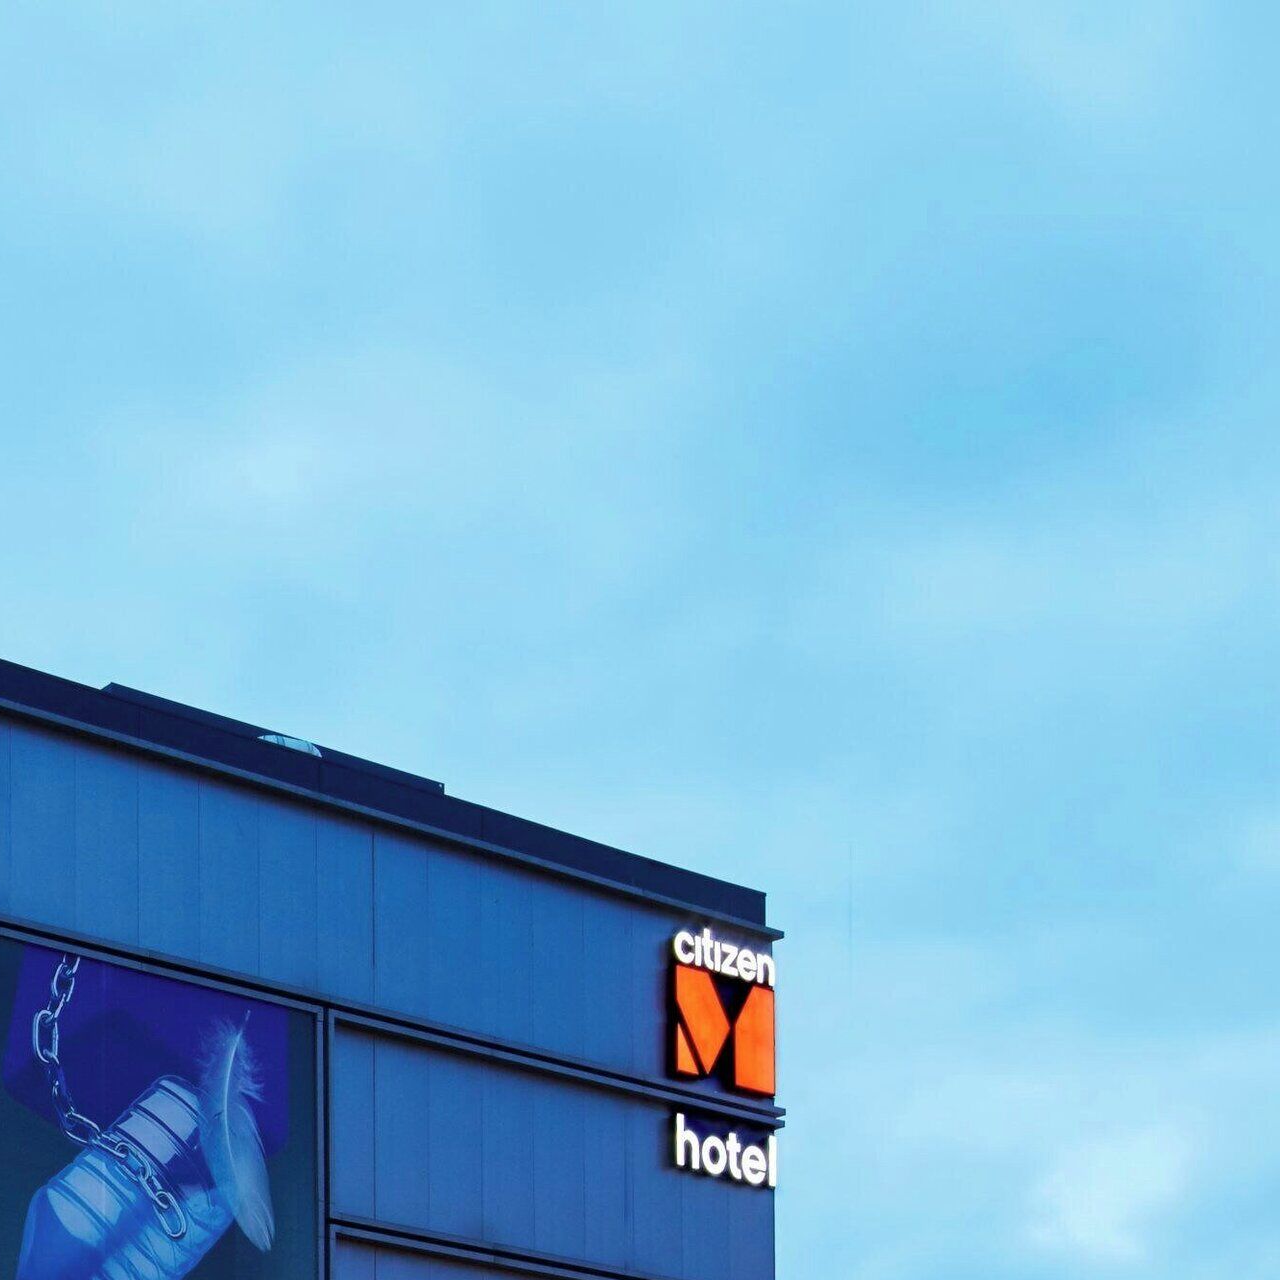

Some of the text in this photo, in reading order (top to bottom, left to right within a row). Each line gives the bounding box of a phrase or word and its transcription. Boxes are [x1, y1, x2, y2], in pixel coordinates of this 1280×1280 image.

[674, 927, 776, 987] citizen
[676, 964, 775, 1097] M
[676, 1112, 777, 1187] hotel
